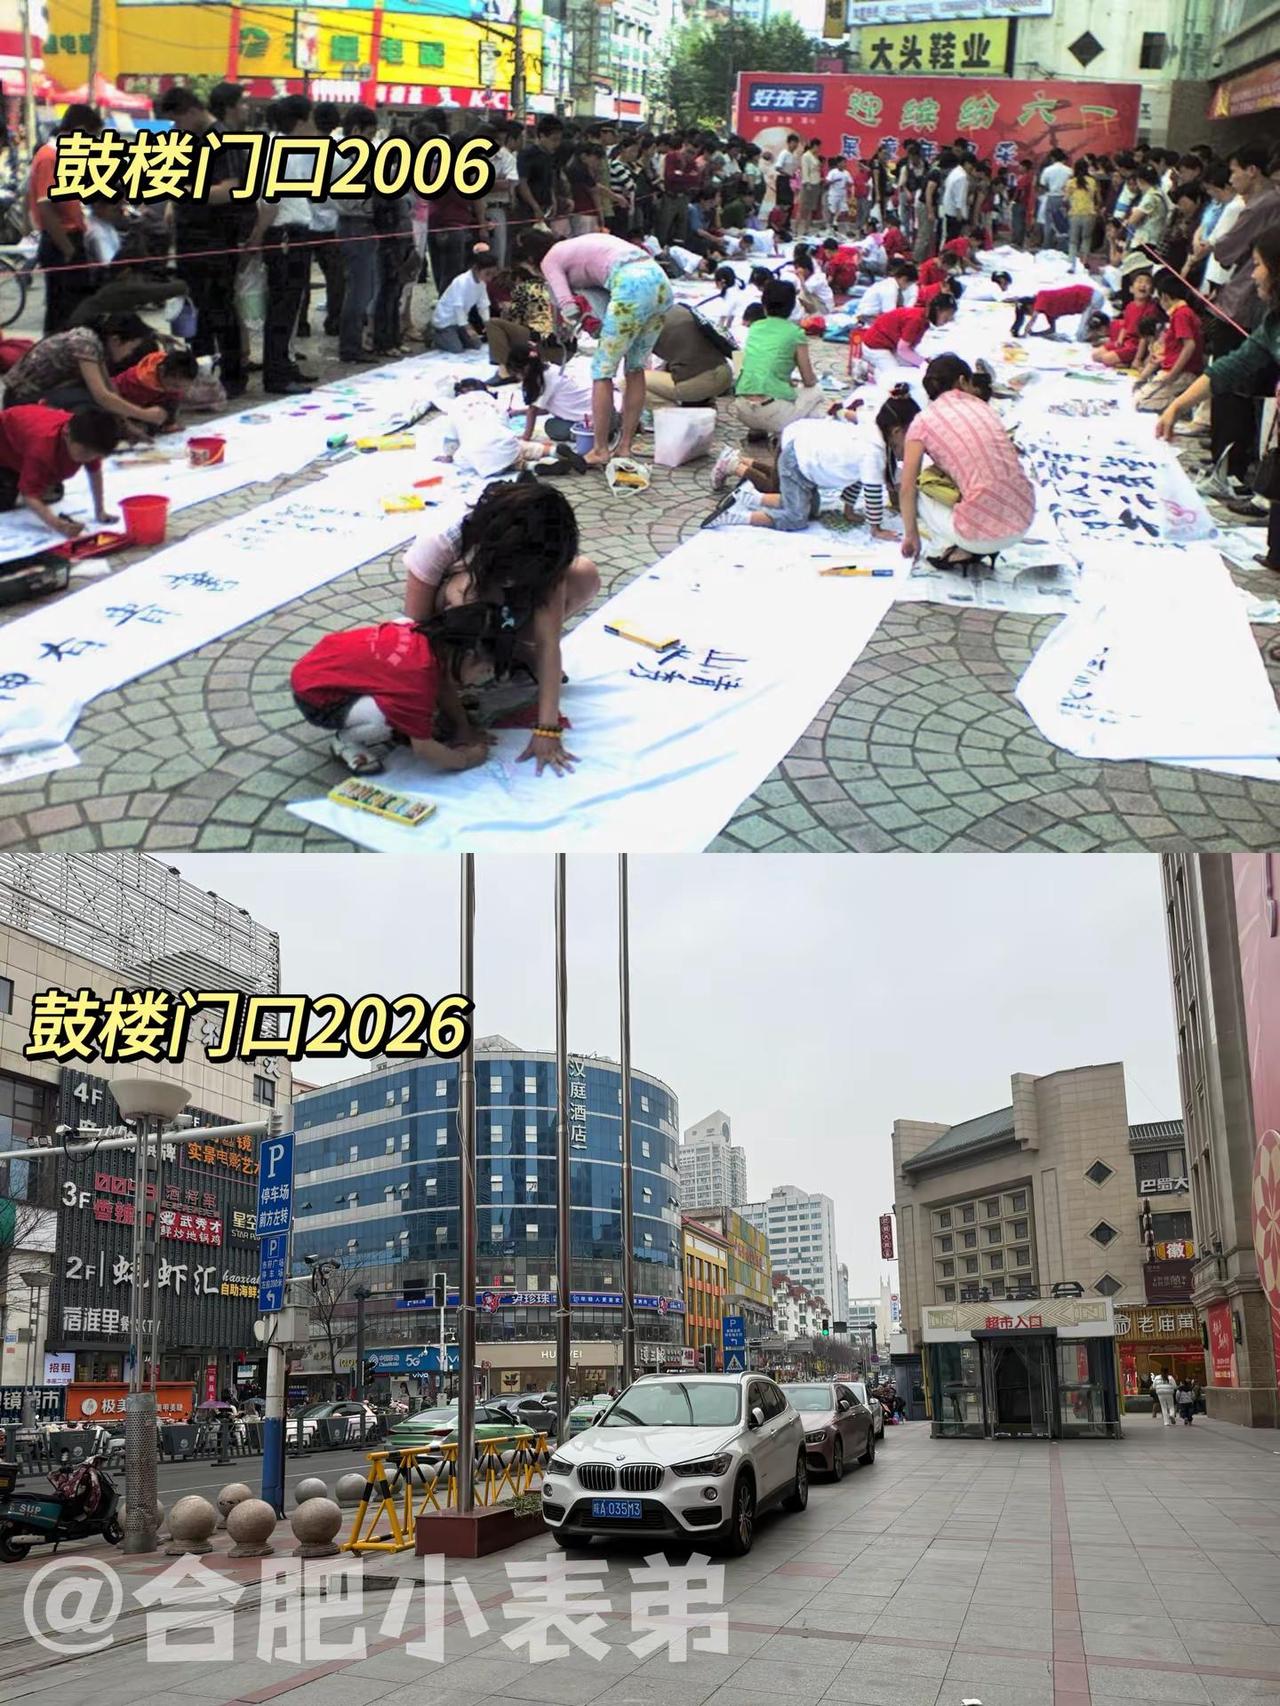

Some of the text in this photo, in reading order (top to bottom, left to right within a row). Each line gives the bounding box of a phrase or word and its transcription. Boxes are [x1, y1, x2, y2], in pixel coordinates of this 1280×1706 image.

[869, 32, 991, 70] 大头鞋业
[751, 88, 818, 108] 好孩子
[73, 1082, 103, 1106] 4F
[569, 1059, 587, 1143] 汉庭酒店
[268, 1144, 284, 1178] P
[61, 1181, 92, 1209] 3F
[261, 1184, 290, 1205] 停车场
[180, 1215, 222, 1234] 武秀才
[259, 1208, 288, 1228] 前方左转
[269, 1239, 278, 1256] P
[66, 1255, 97, 1280] 2F
[221, 1284, 261, 1299] 自助海鲜
[985, 1315, 1043, 1328] 超市入口
[1137, 1314, 1202, 1332] 老庙黄
[49, 1363, 71, 1373] 招租
[405, 1354, 421, 1367] 5G
